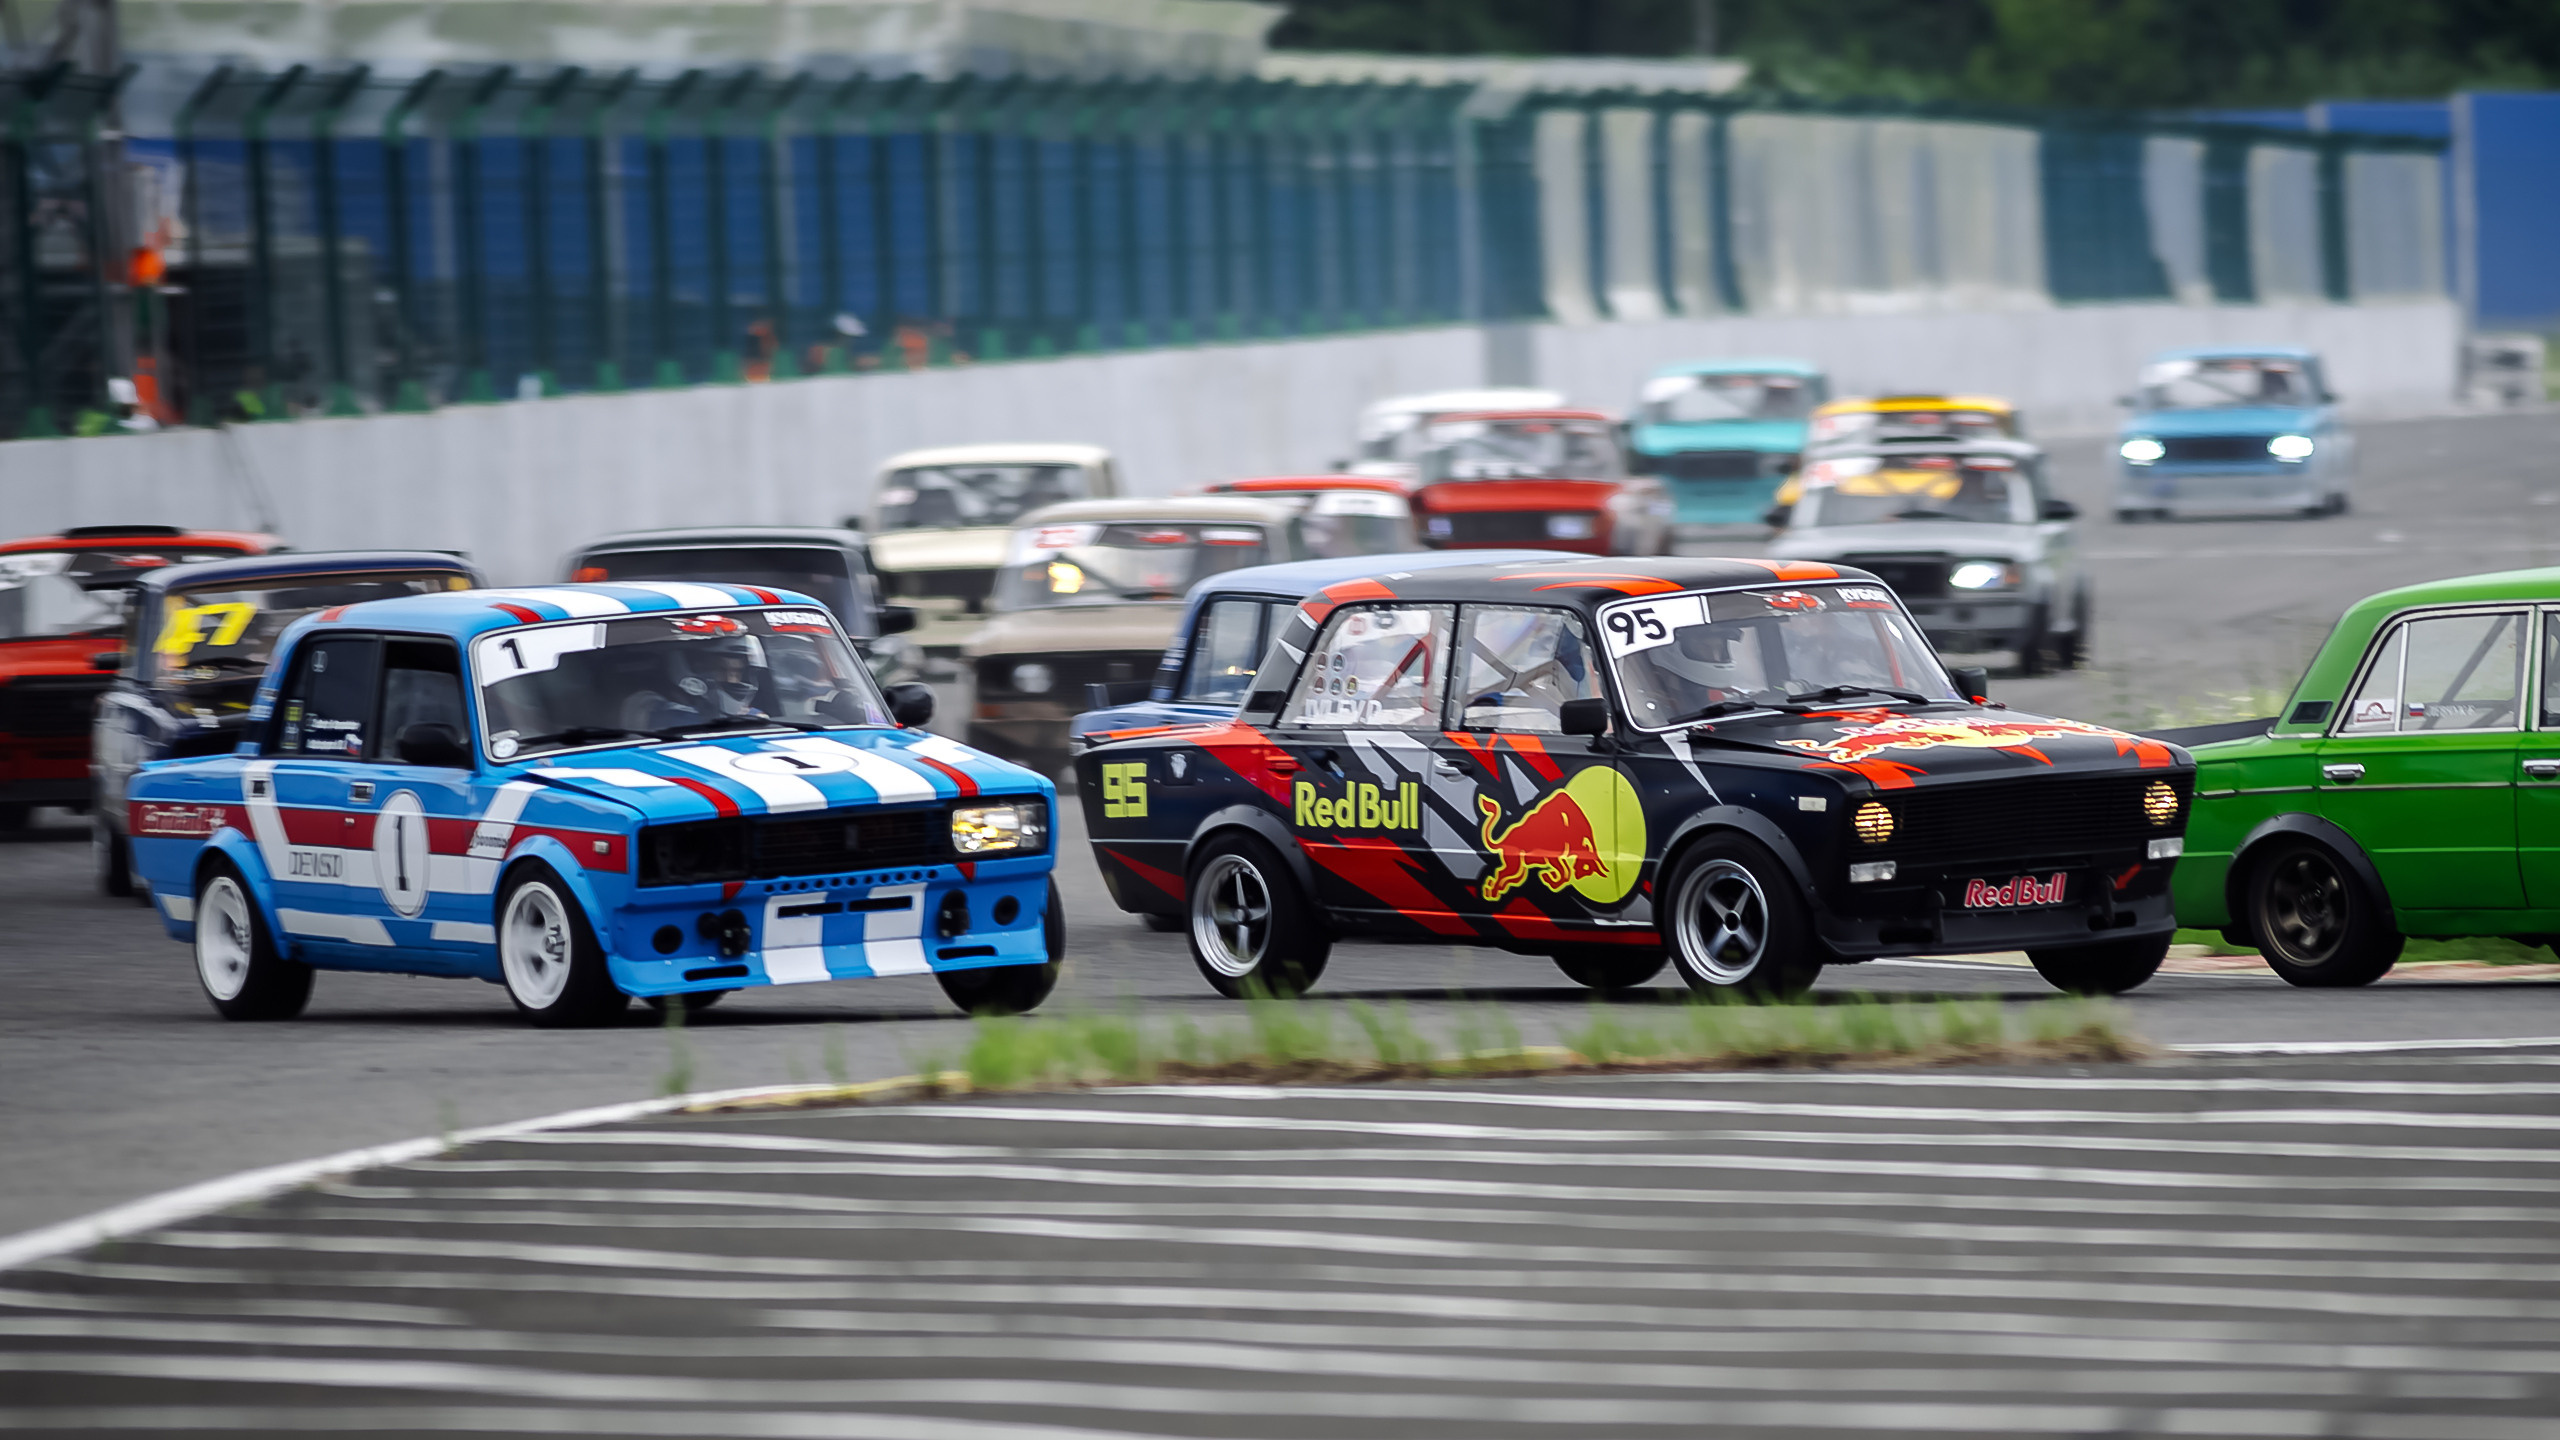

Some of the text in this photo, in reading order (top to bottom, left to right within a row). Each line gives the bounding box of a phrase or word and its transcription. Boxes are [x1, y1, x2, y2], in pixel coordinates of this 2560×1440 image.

[1607, 608, 1667, 645] 95
[499, 638, 527, 669] 1
[771, 756, 821, 769] 1
[1102, 762, 1148, 818] 95
[1295, 780, 1418, 829] Red Bull
[393, 816, 410, 891] 1
[1964, 872, 2067, 908] Red Bull
